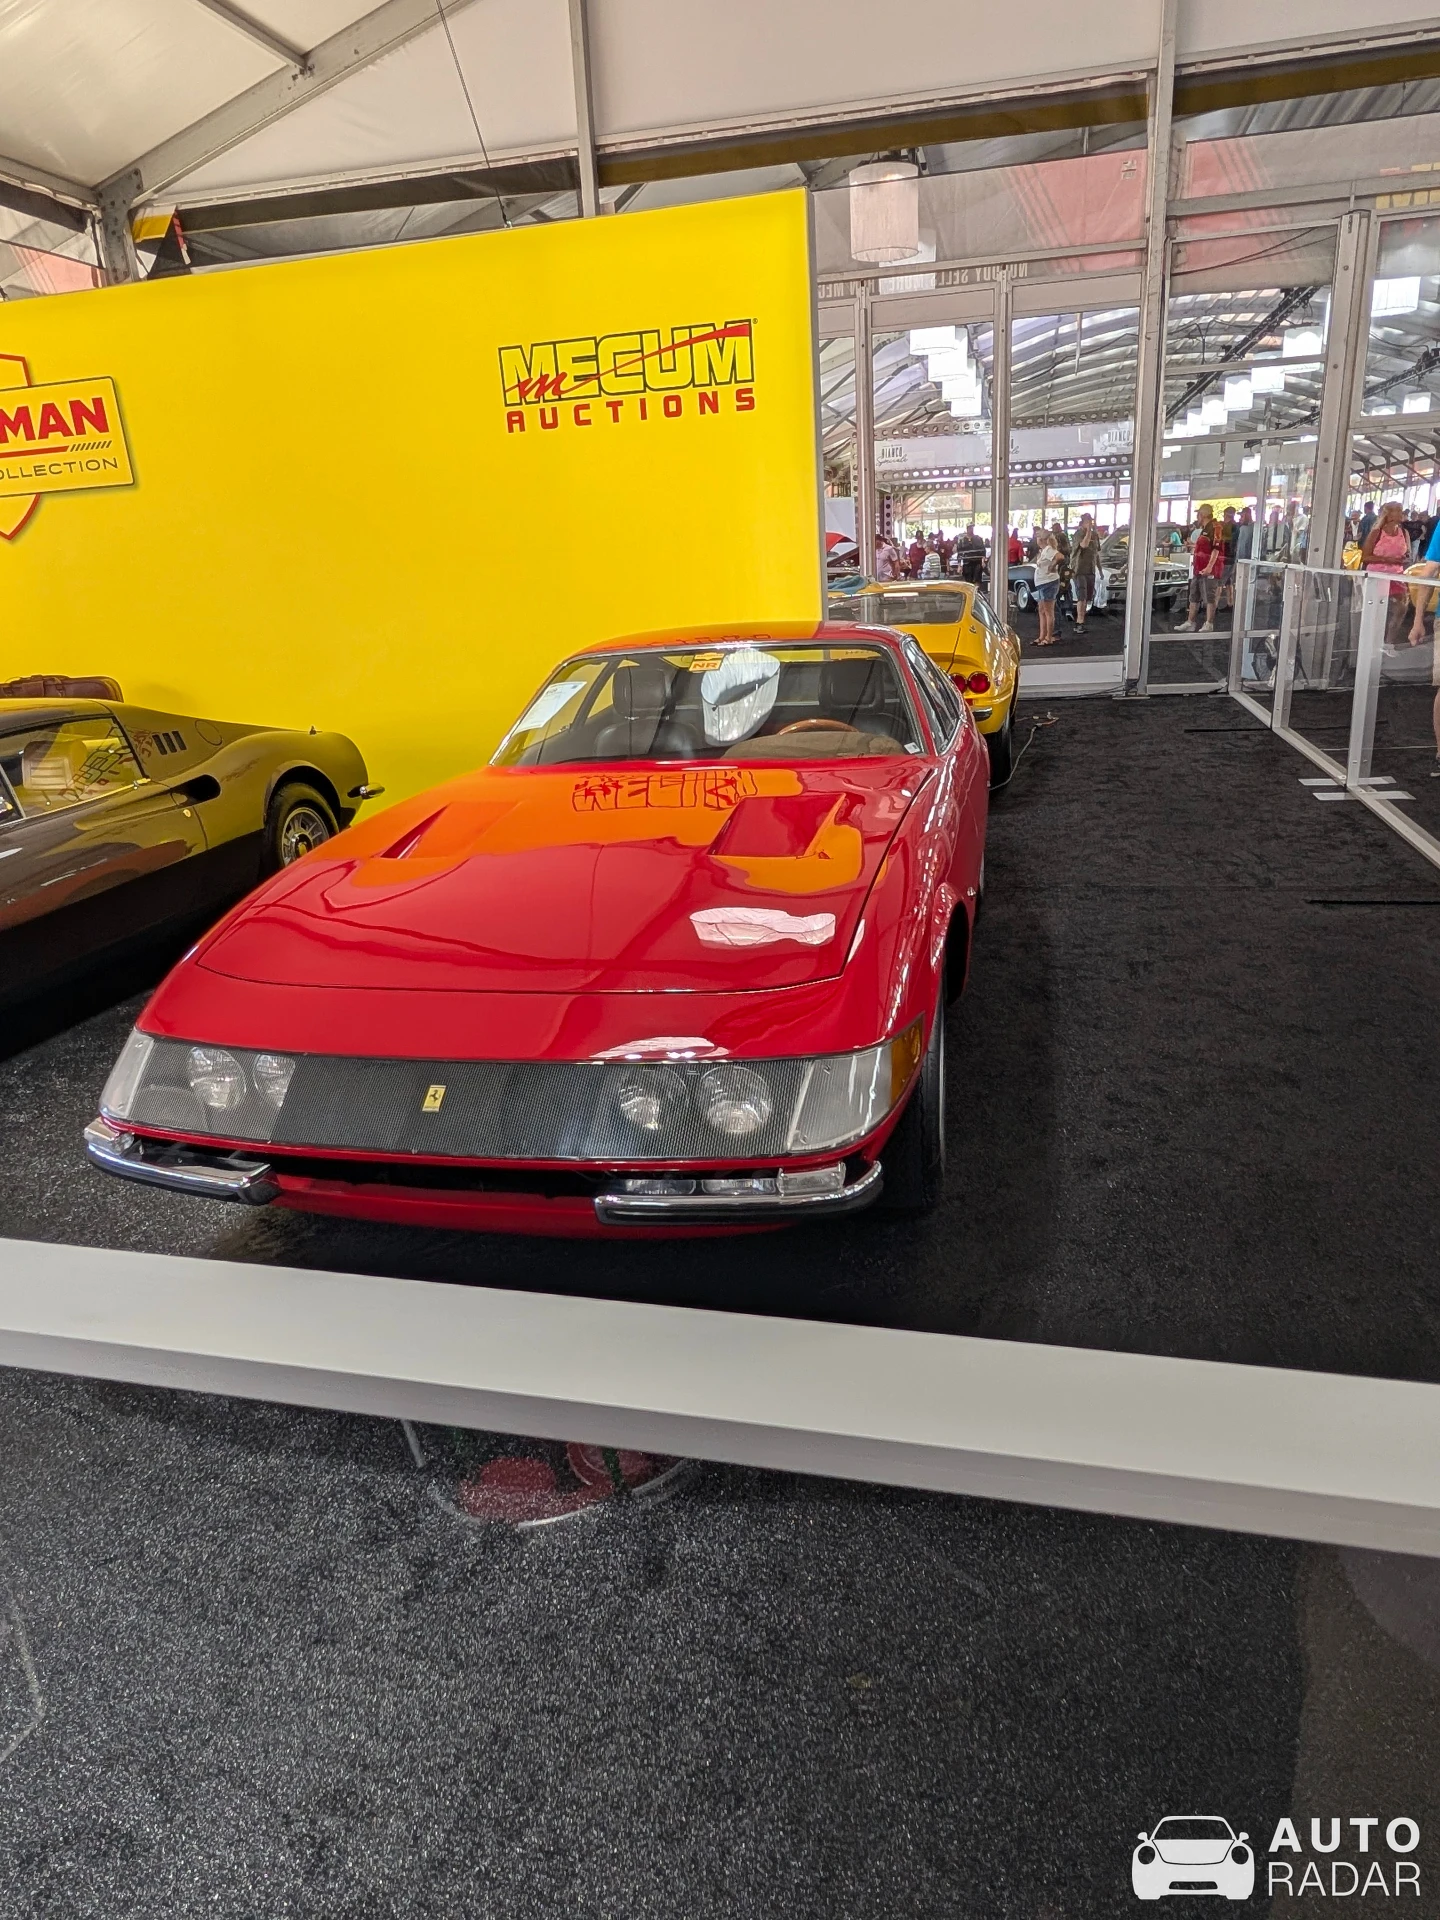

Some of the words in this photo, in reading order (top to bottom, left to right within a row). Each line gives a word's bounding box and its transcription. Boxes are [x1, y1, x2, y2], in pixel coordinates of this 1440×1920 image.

[498, 318, 754, 407] MECUM
[506, 387, 756, 433] AUCTIONS
[0, 457, 118, 480] LLECTION
